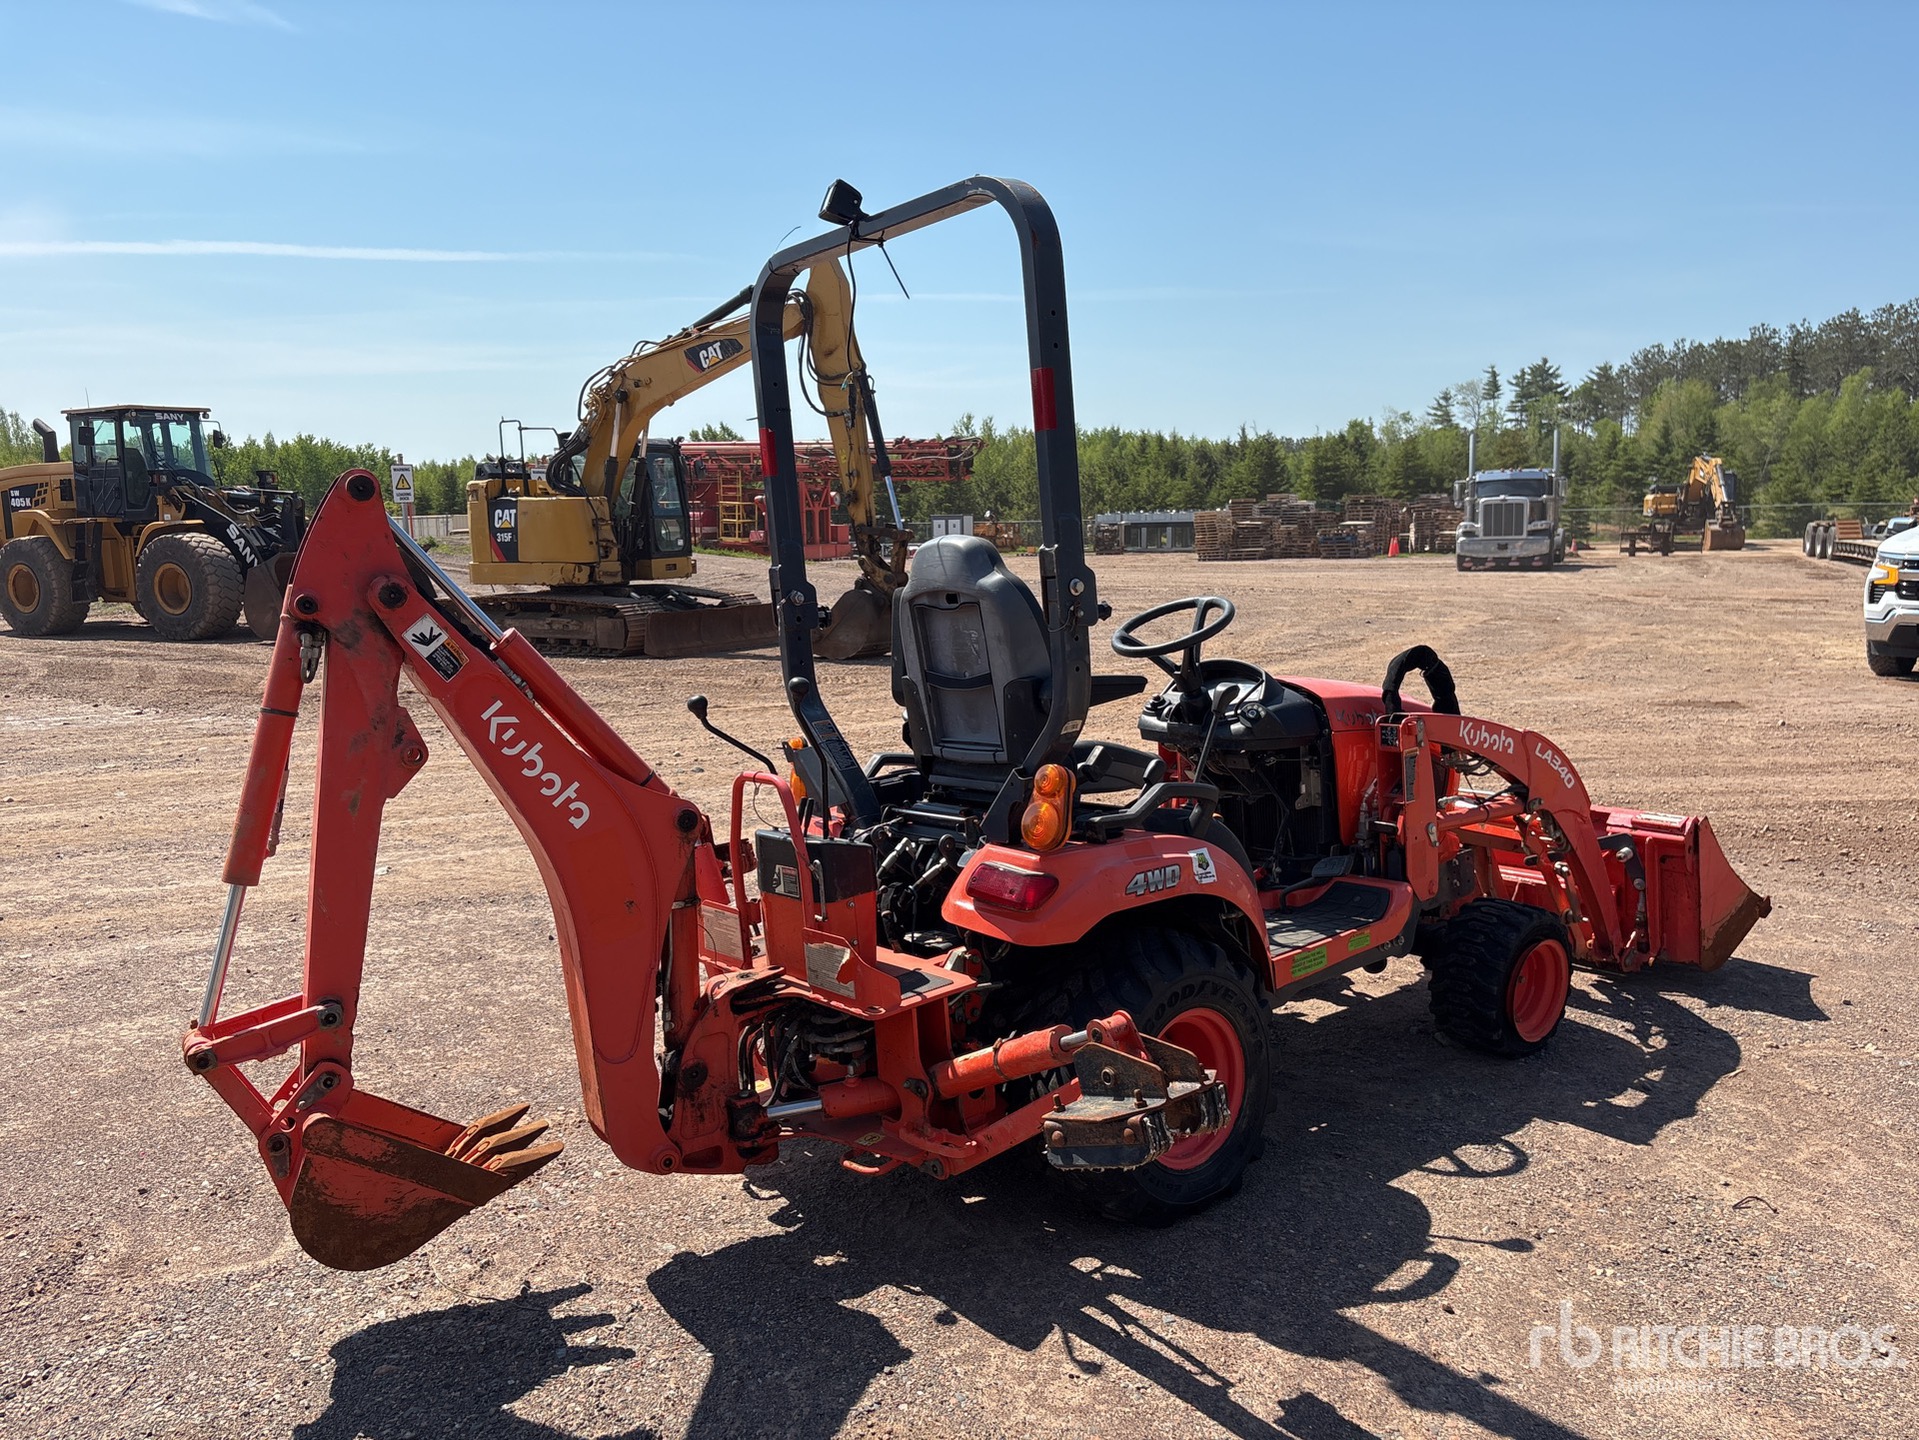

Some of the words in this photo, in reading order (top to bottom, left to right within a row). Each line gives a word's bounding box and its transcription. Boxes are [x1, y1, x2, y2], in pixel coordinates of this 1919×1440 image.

[699, 341, 723, 369] CAT
[154, 412, 184, 421] SANY
[494, 509, 516, 528] CAT
[496, 532, 512, 543] 315F
[1335, 708, 1378, 727] Kubot
[1459, 720, 1514, 754] Kubota
[481, 700, 590, 829] Kubota
[1535, 743, 1575, 789] LA340
[1125, 864, 1181, 896] 4WD
[1144, 979, 1259, 1035] GOODYEAR
